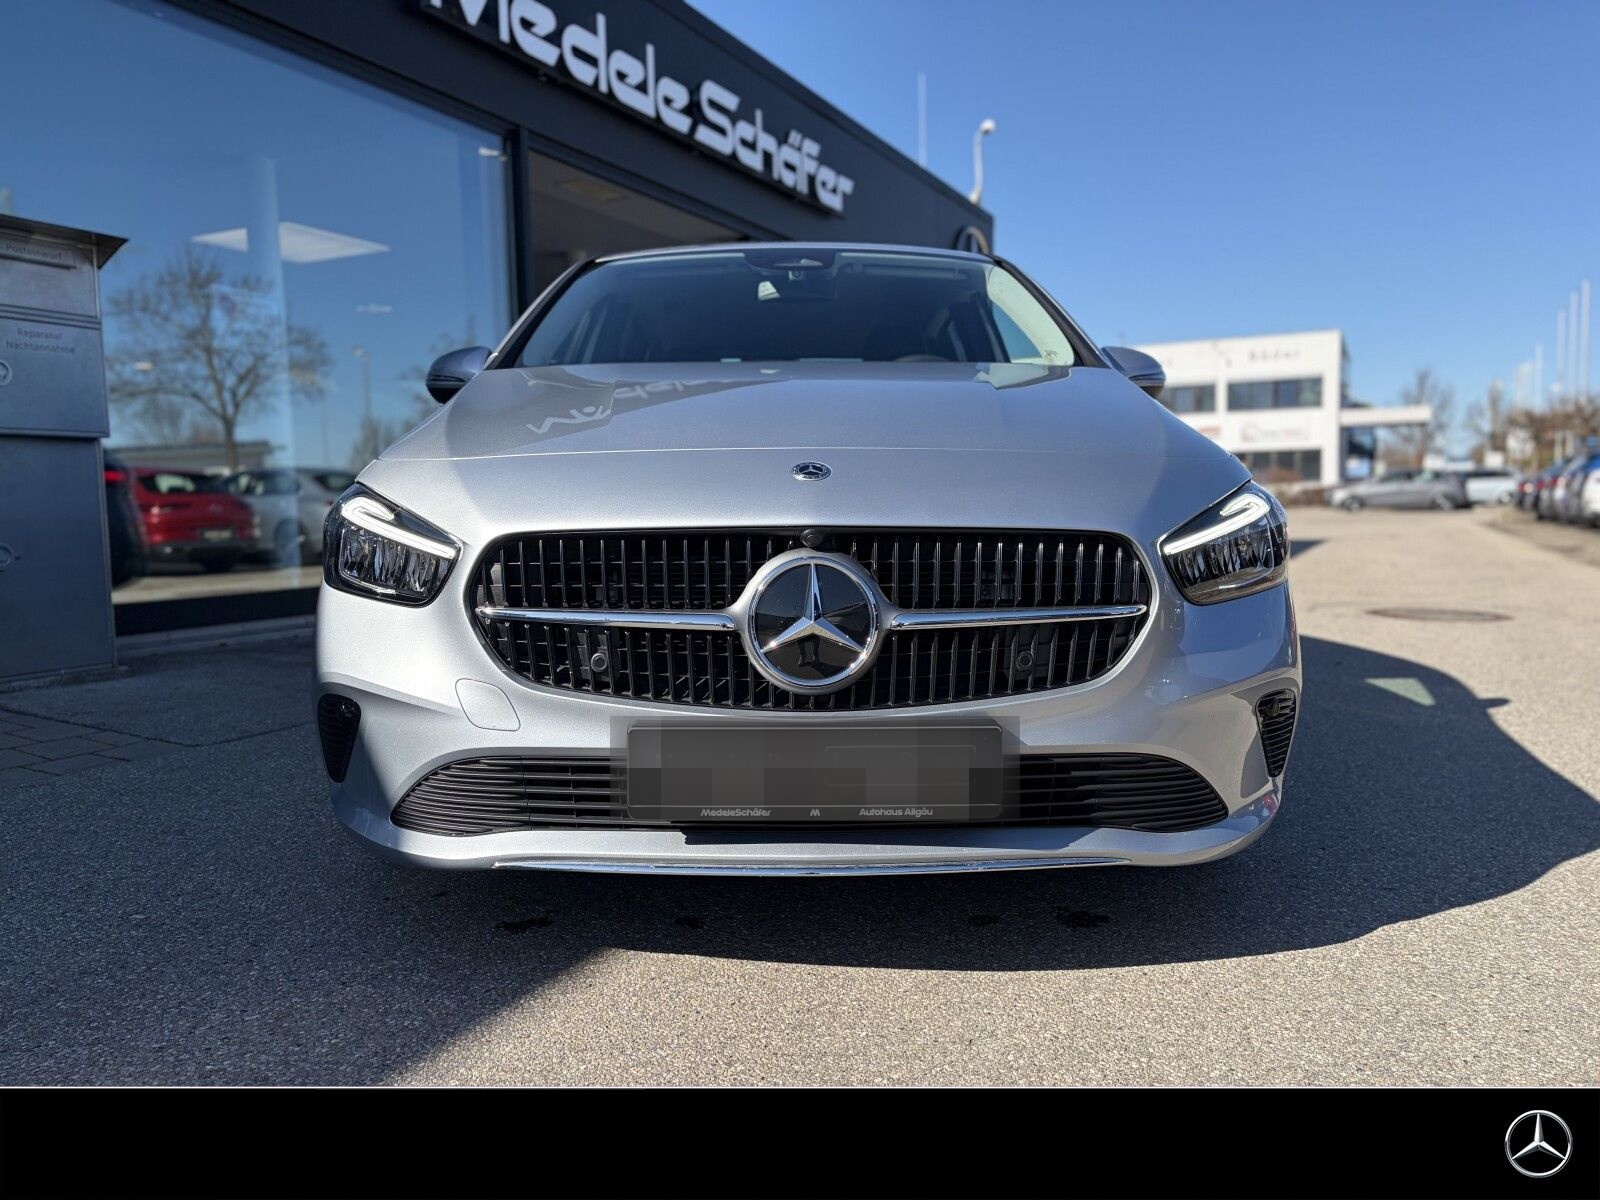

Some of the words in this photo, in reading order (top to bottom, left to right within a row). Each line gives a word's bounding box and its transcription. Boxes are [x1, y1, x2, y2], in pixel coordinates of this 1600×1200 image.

[17, 327, 63, 340] Reparatur
[6, 339, 76, 354] Nachtannahme
[859, 807, 903, 817] Autohaus
[904, 806, 933, 817] Allgäu
